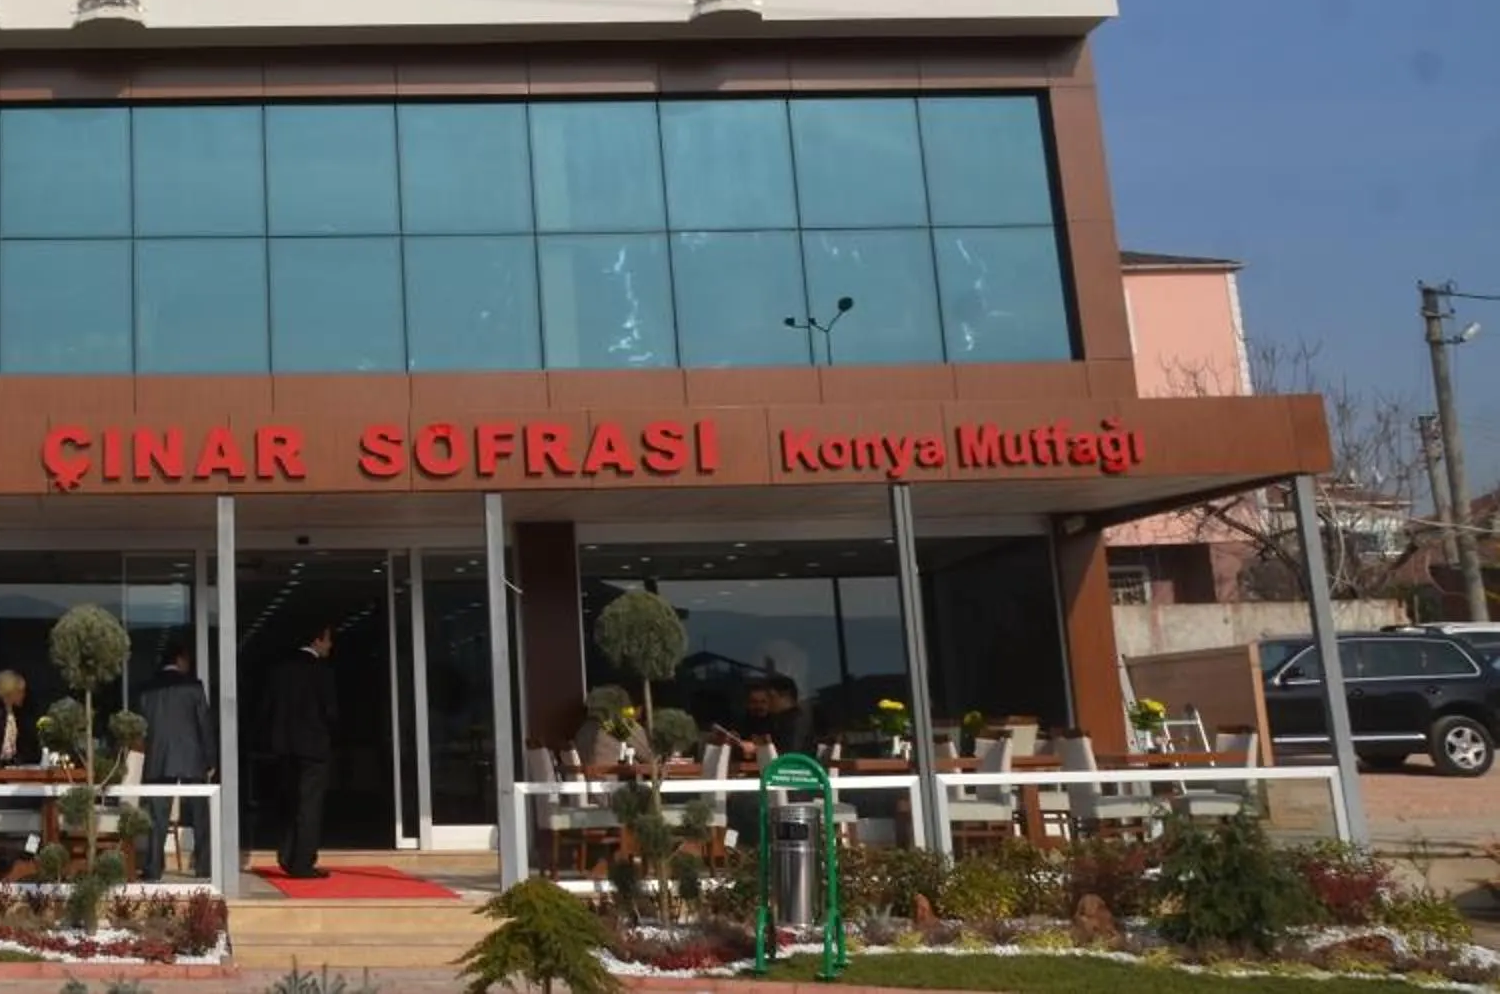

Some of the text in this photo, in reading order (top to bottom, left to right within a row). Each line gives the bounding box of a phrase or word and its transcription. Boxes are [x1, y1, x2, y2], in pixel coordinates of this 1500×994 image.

[41, 416, 1147, 491] ÇINAR SOFRASI Konya Mutfağı
